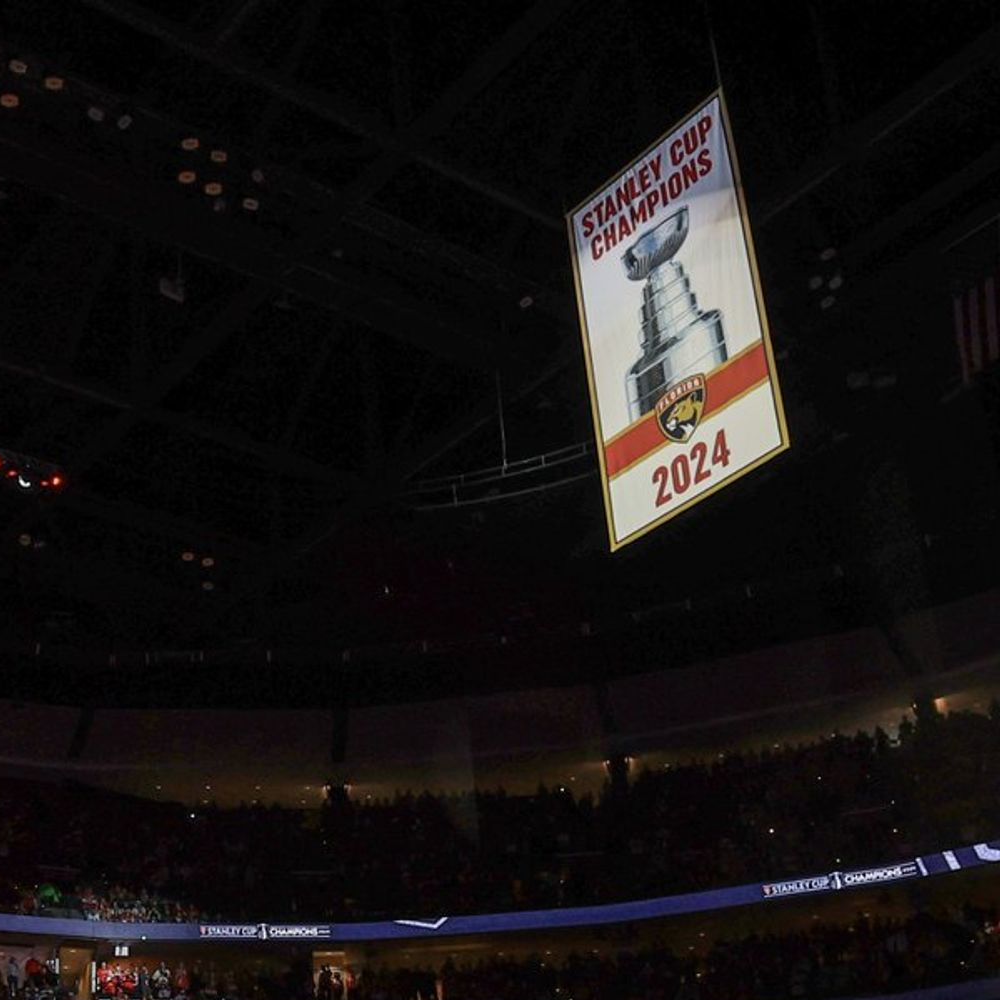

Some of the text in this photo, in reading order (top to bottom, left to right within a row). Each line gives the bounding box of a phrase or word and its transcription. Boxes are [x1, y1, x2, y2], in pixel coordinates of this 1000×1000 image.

[581, 116, 712, 238] STANLEY CUP
[591, 149, 712, 260] CHAMPIONS
[652, 428, 731, 507] 2024
[772, 880, 811, 893] STANLEY
[812, 878, 829, 889] CUP
[845, 867, 902, 883] CHAMPIONS
